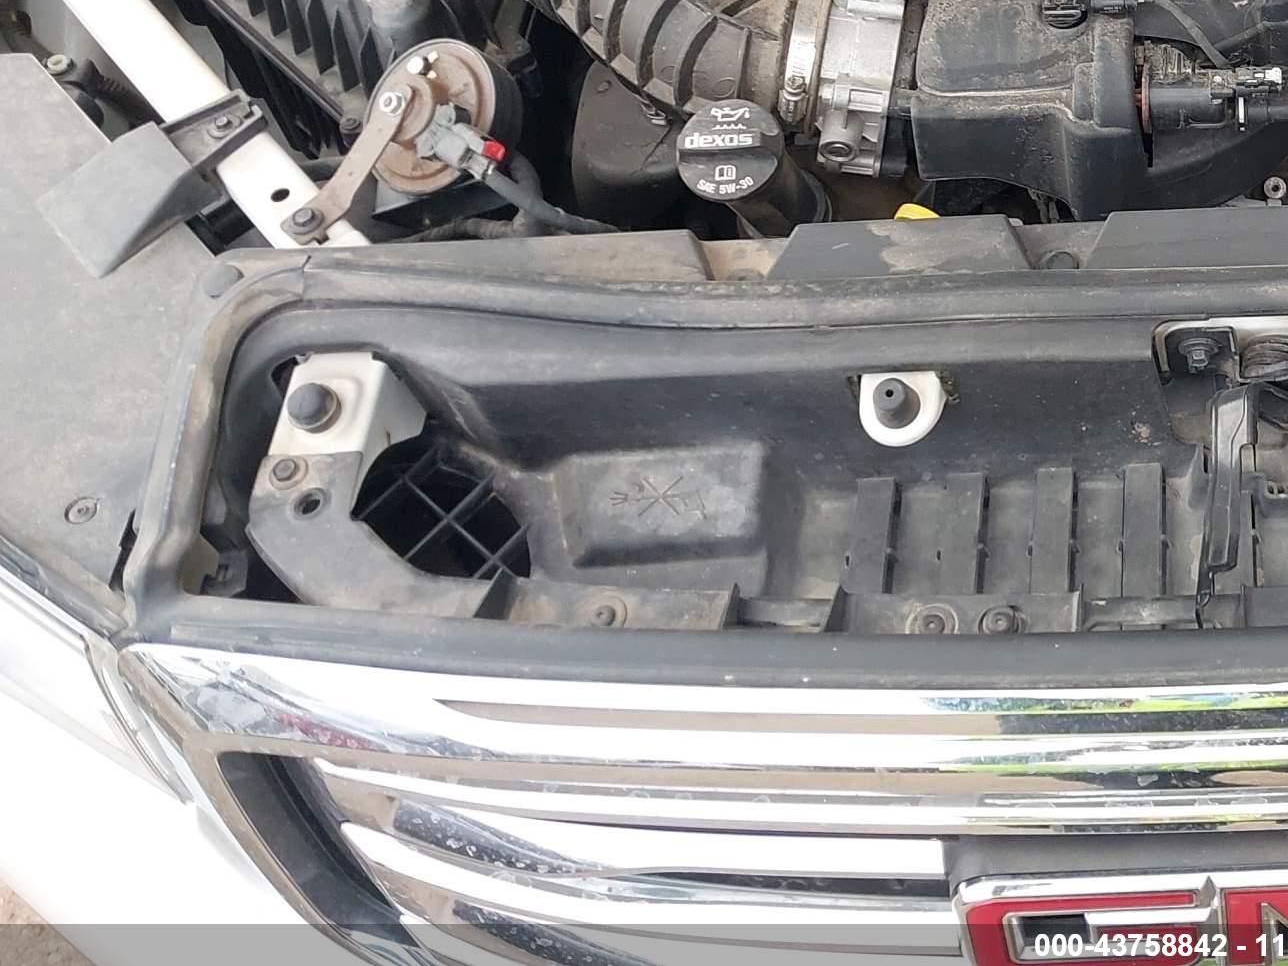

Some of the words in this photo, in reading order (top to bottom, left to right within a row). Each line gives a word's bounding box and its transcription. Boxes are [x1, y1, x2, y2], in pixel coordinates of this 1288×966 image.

[685, 132, 753, 149] dexos
[696, 179, 717, 194] SAE
[719, 176, 754, 194] 5W-30
